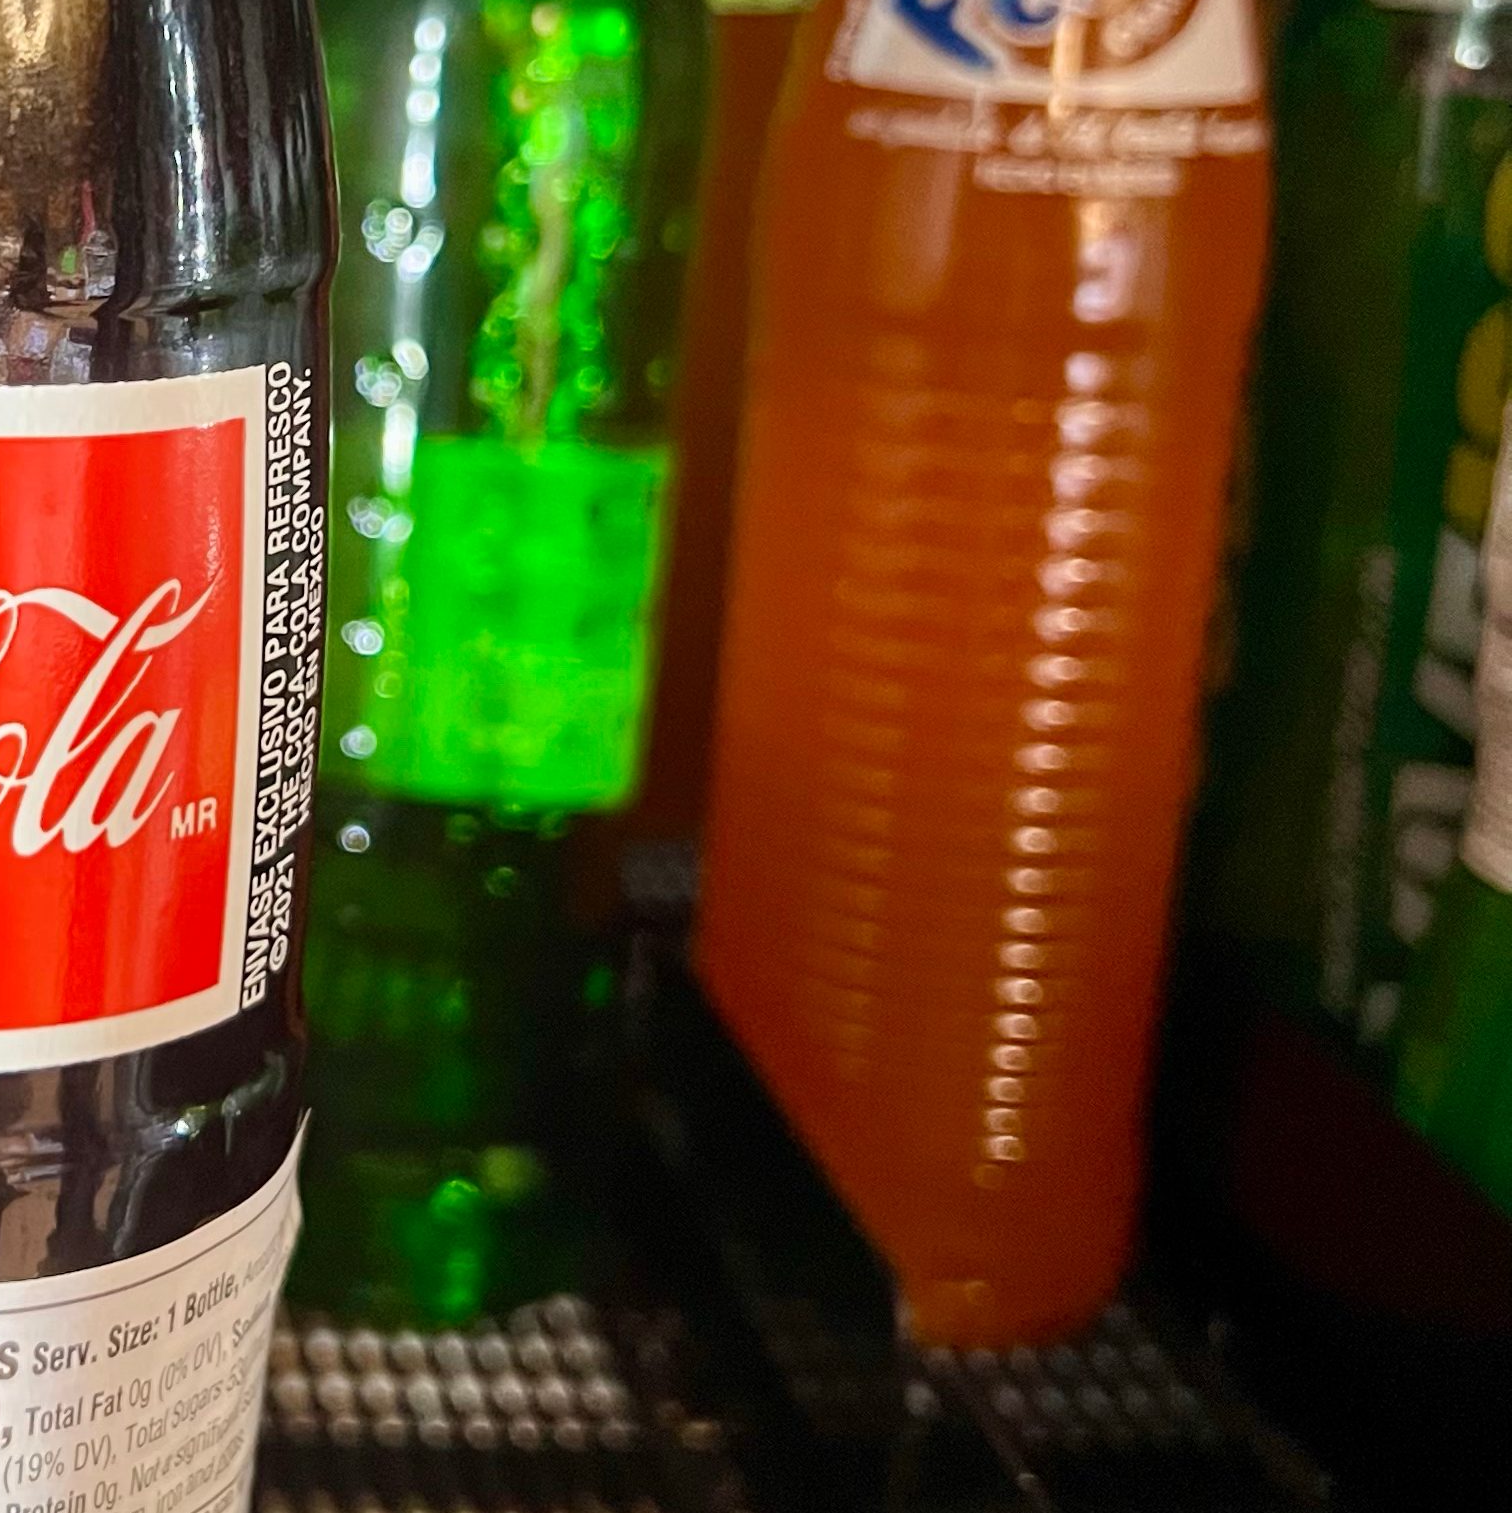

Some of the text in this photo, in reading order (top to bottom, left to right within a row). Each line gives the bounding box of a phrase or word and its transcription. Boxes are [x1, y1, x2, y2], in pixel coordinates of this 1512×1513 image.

[291, 368, 312, 554] COMPANY.
[242, 360, 292, 1010] ENVASE EXCLUSIVO PARA REFRESCO
[284, 559, 310, 767] COCA-COLA
[305, 648, 320, 701] EN
[170, 796, 218, 841] MR
[279, 771, 303, 848] THE
[298, 706, 317, 827] HECHO
[31, 1339, 98, 1376] Serv.
[107, 1315, 160, 1359] Size:
[167, 1300, 177, 1334] 1
[183, 1271, 240, 1326] Bottle,
[24, 1396, 84, 1437] Total
[90, 1385, 124, 1423] Fat
[128, 1377, 153, 1409] 0g
[158, 1354, 189, 1402] (0%
[192, 1330, 227, 1372] DV),
[2, 1447, 65, 1493] (19%
[73, 1434, 117, 1474] DV),
[125, 1407, 171, 1454] Total
[93, 1480, 123, 1510] 0g.
[130, 1455, 162, 1497] Not
